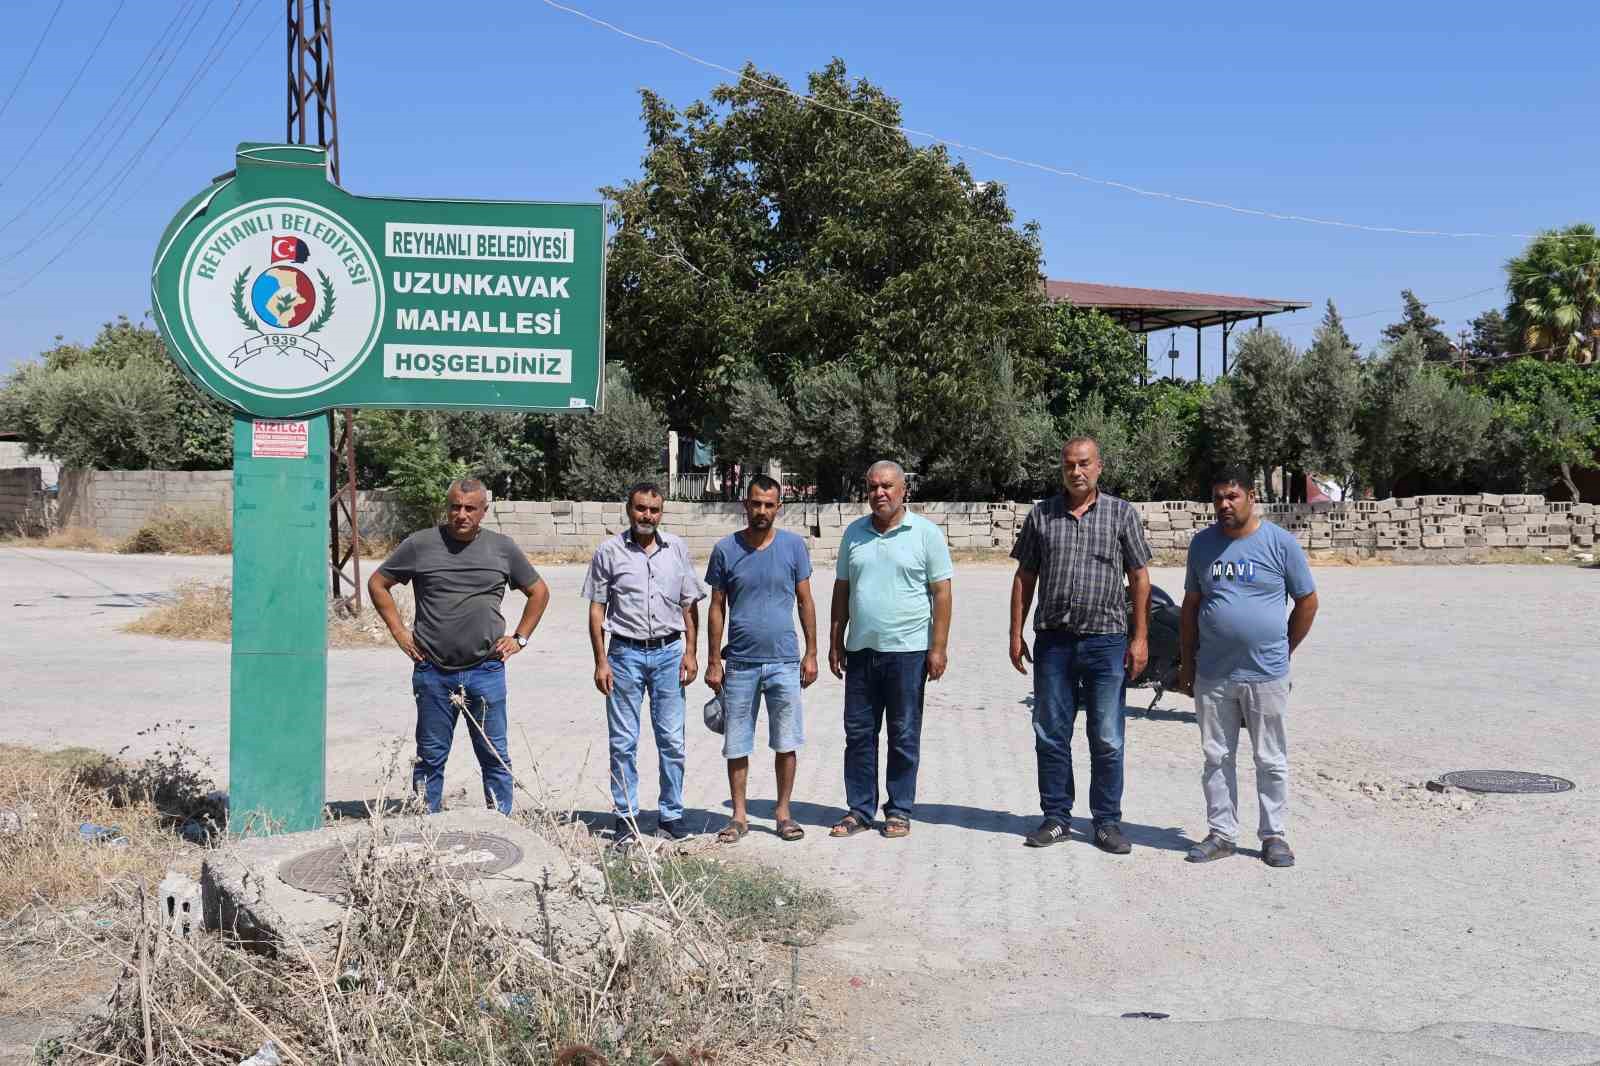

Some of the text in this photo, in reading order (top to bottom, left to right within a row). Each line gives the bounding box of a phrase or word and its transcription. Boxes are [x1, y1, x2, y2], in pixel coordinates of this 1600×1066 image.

[197, 213, 372, 285] REYHANLI BELEDİYESİ
[393, 231, 568, 259] REYHANLI BELEDİYESİ
[393, 271, 570, 298] UZUNKAVAK
[396, 308, 561, 335] MAHALLESİ
[263, 336, 297, 346] 1939
[395, 352, 562, 376] HOŞGELDİNİZ
